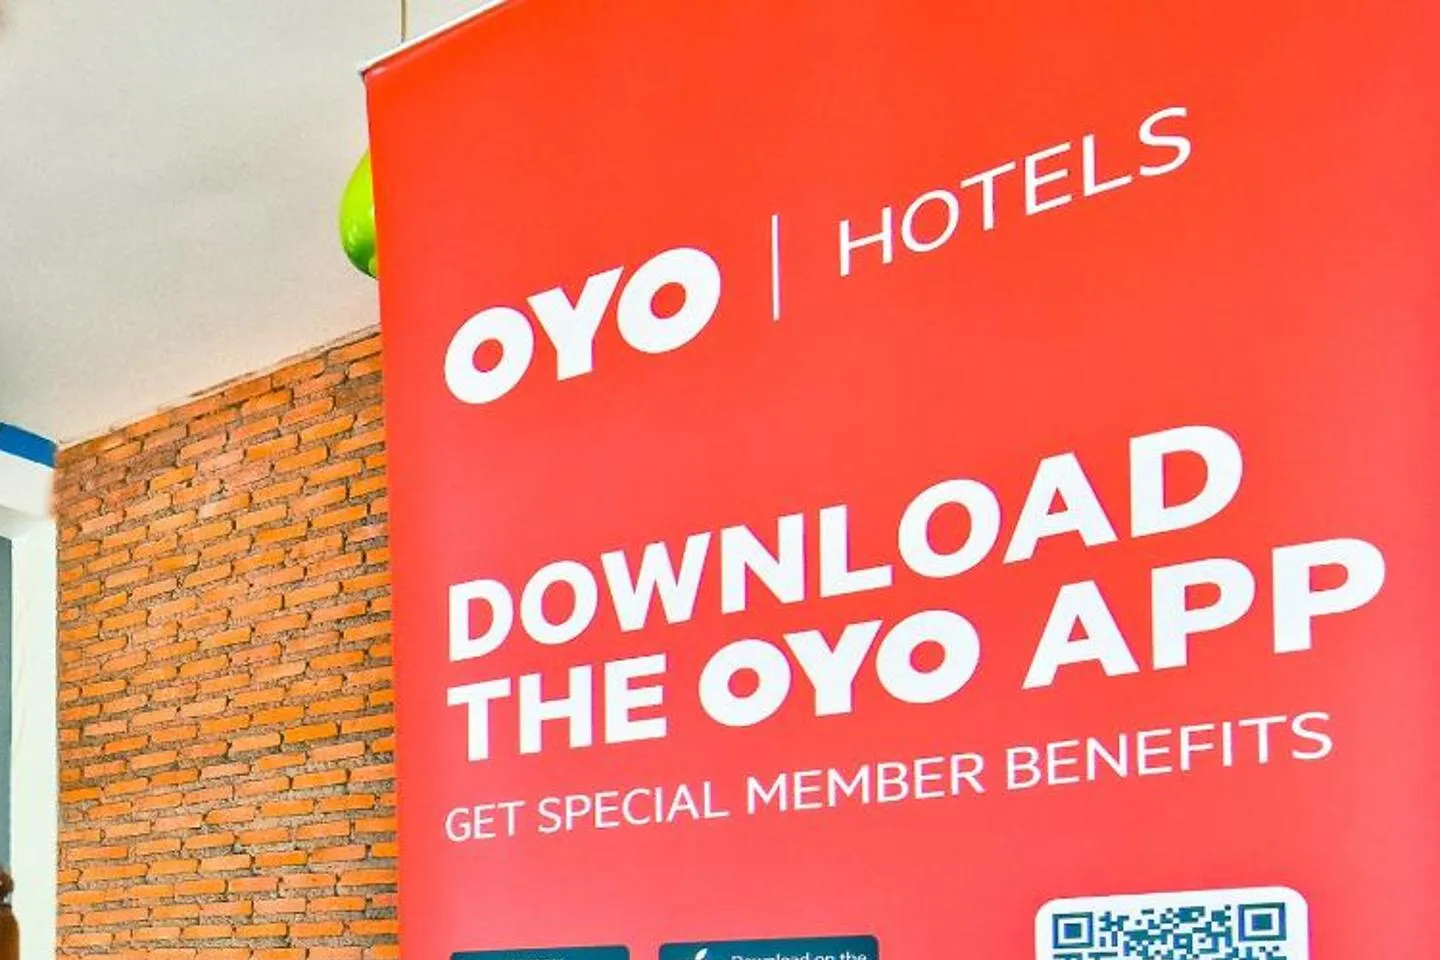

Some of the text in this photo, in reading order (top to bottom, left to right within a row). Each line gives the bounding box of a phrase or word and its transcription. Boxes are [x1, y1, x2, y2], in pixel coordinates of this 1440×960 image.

[444, 106, 1192, 404] OYO HOTELS
[447, 537, 1386, 762] THE OYO APP
[448, 424, 1244, 662] DOWNLOAD
[444, 710, 1334, 843] GET SPECIAL MEMBER BENEFITS
